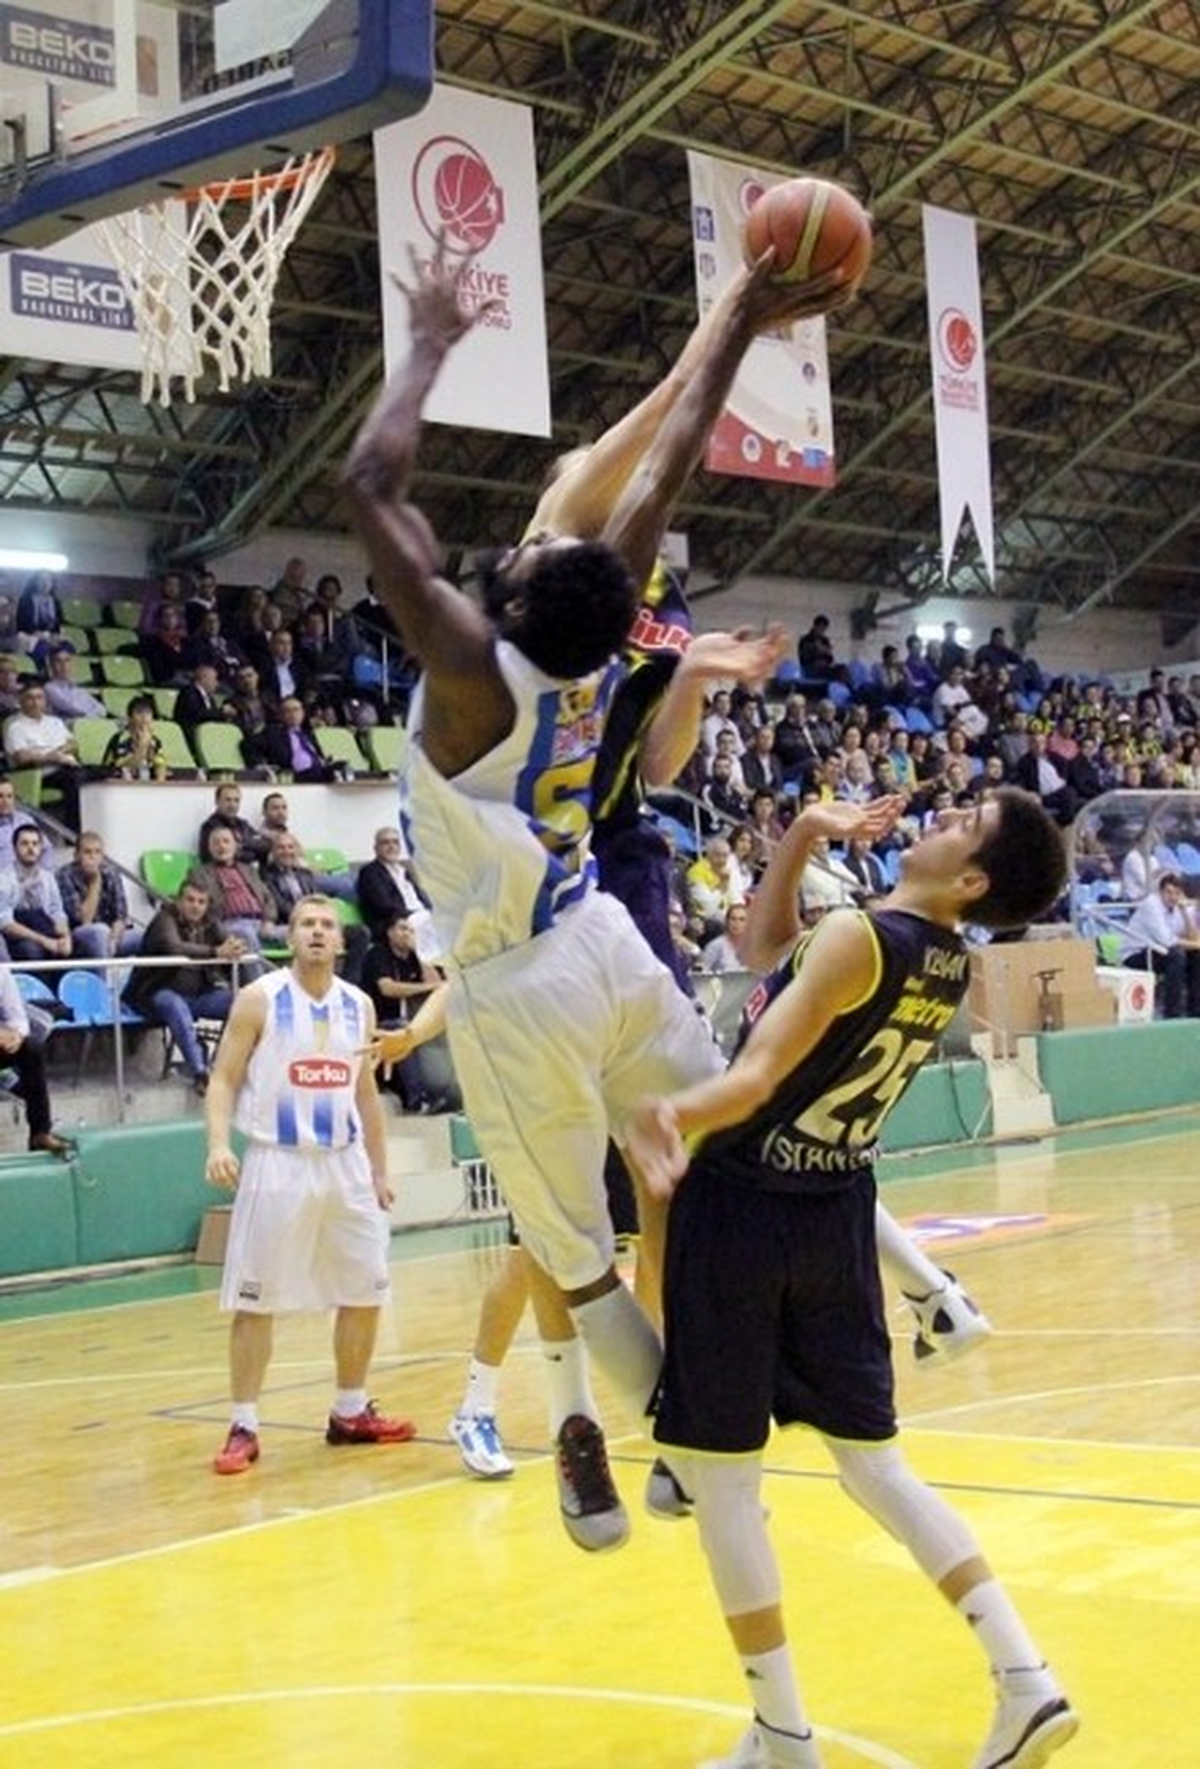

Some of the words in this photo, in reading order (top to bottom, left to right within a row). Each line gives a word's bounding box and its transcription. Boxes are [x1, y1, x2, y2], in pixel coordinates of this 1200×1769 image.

[10, 22, 113, 67] BEKO
[21, 270, 125, 310] BEKO
[293, 1064, 347, 1083] Torku
